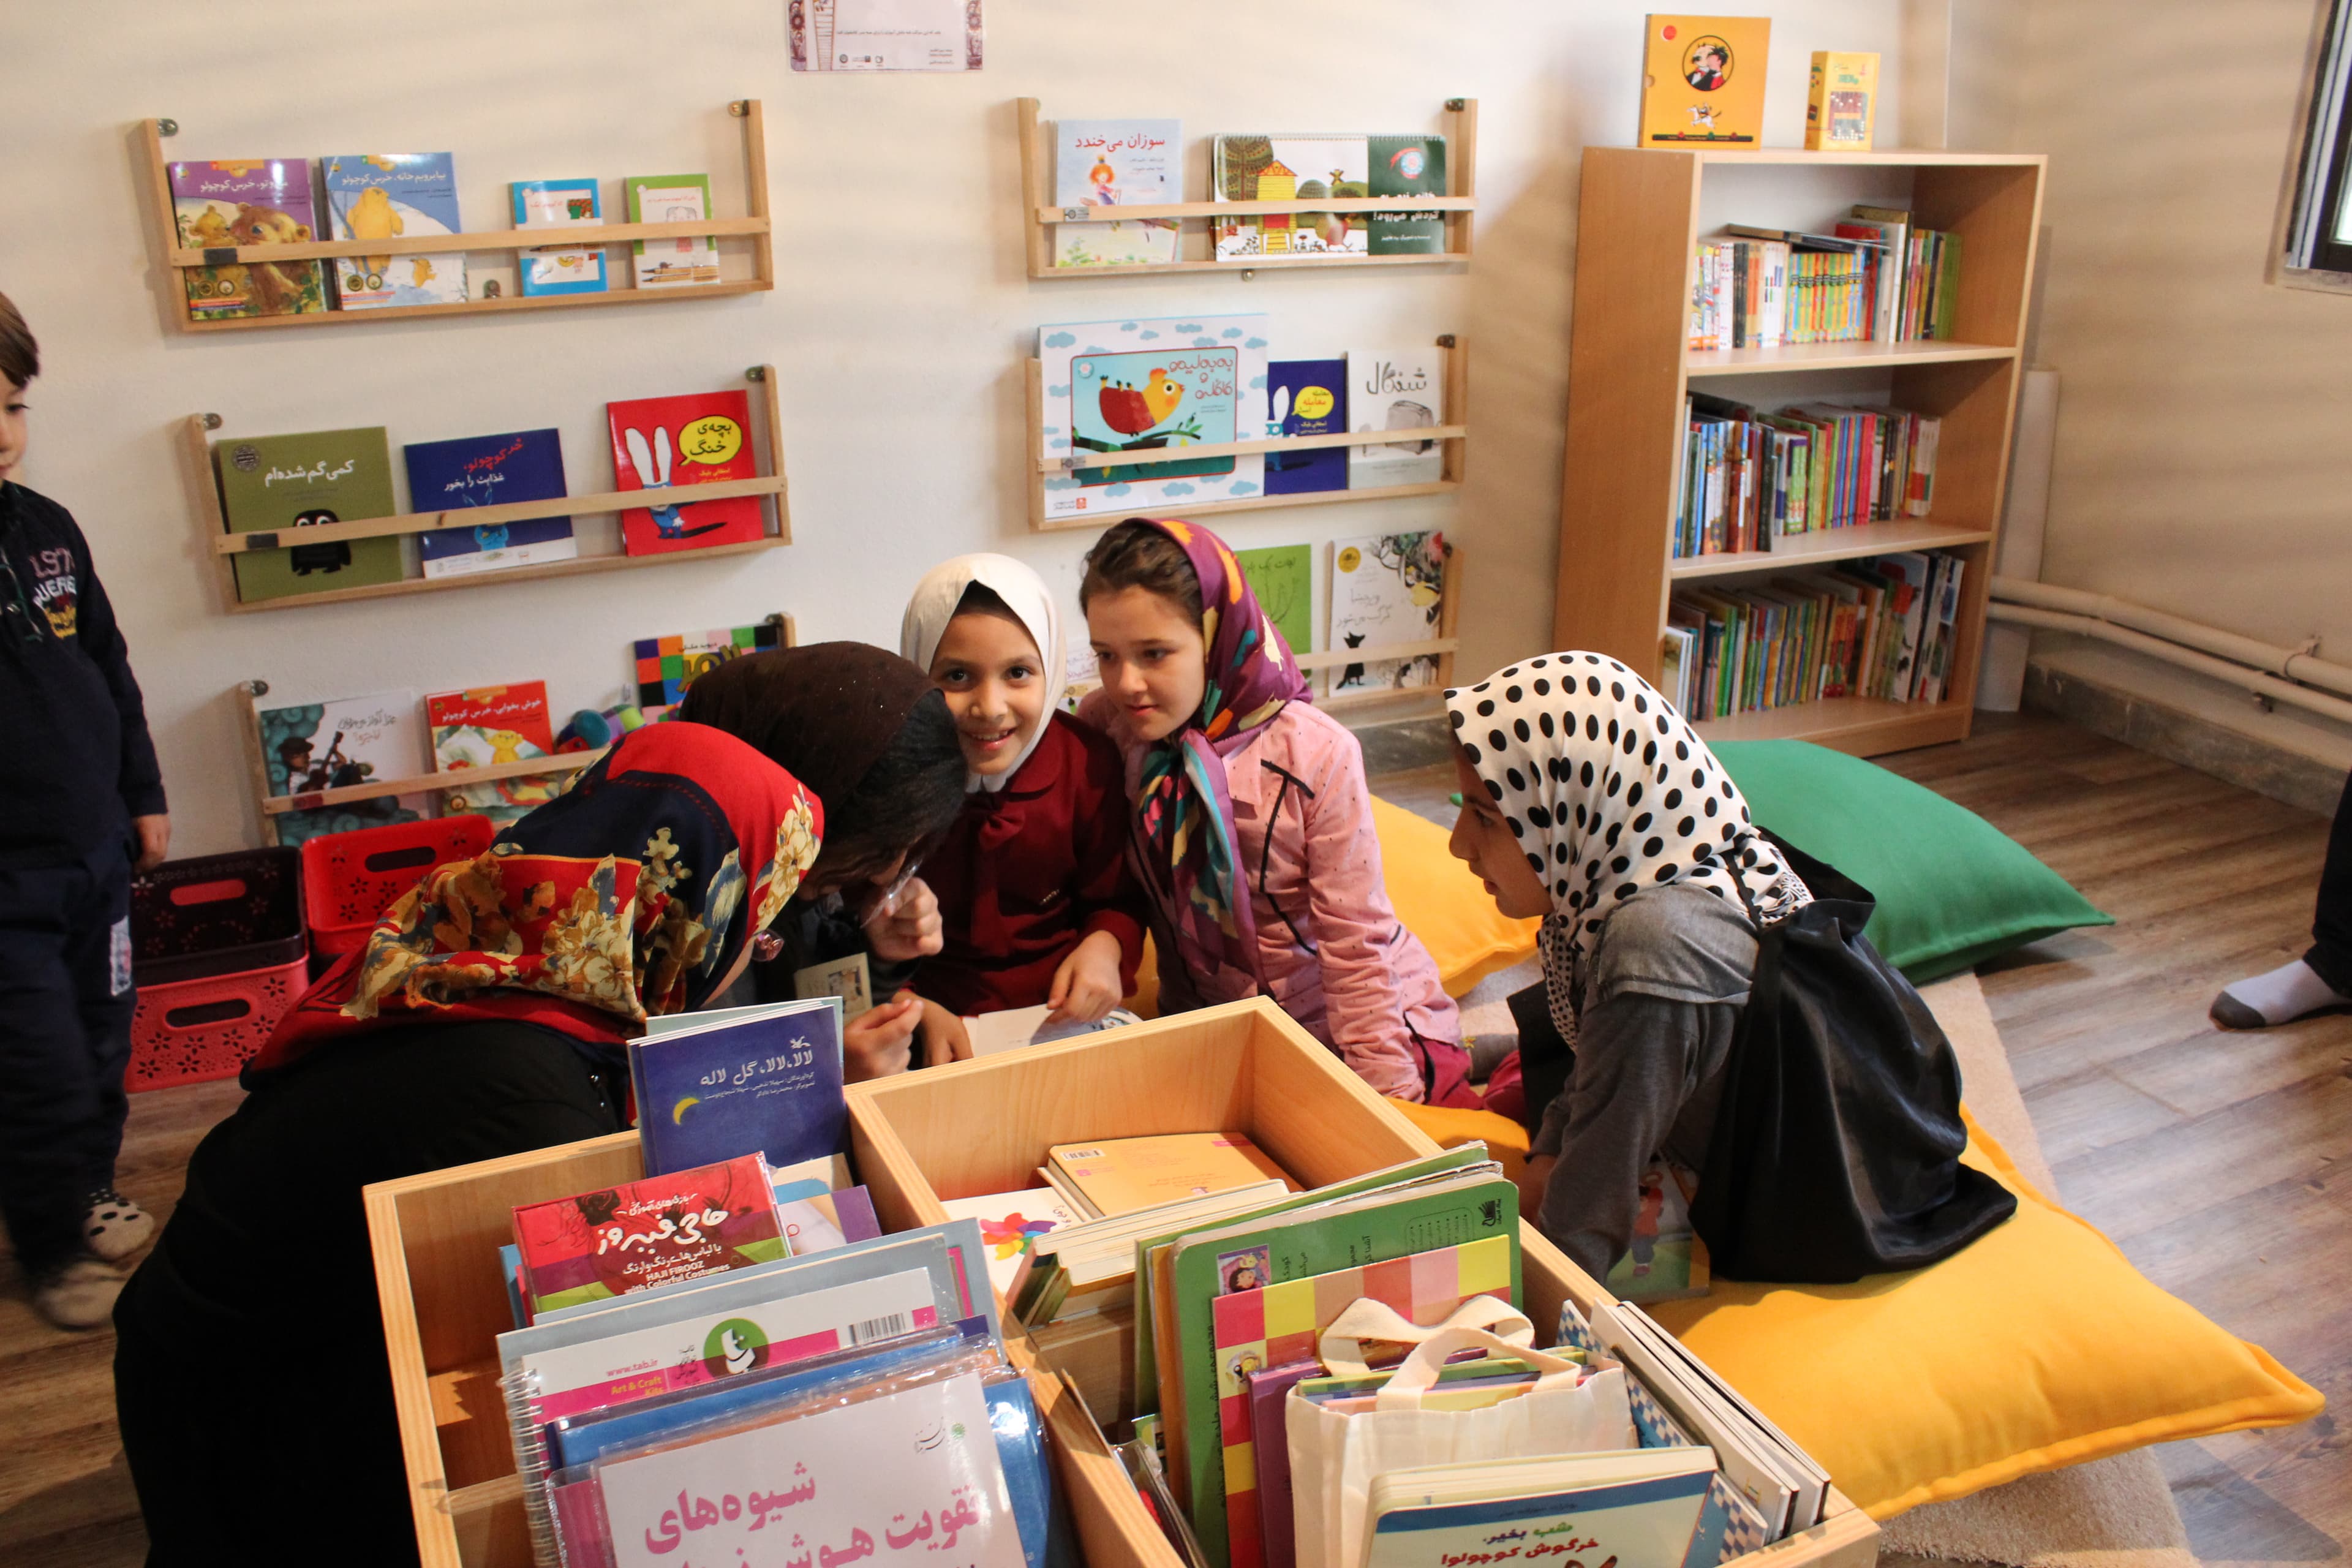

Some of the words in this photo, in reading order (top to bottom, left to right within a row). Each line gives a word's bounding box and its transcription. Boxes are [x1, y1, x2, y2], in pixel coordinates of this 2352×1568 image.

[1127, 133, 1166, 150] سوزان
[200, 179, 231, 192] کوچولو
[231, 179, 255, 192] خرس
[342, 173, 371, 186] کوچولو
[370, 176, 393, 185] خرس
[690, 439, 726, 456] خنگ
[307, 461, 326, 484] گم
[326, 459, 355, 480] کمی
[444, 478, 466, 491] بخور
[467, 474, 475, 488] را
[477, 472, 505, 486] غذایت
[521, 698, 541, 710] خوش
[442, 709, 468, 722] کوچولو
[700, 1068, 726, 1086] لاله
[733, 1060, 758, 1085] گل
[597, 1213, 677, 1256] فیروز
[674, 1208, 729, 1245] حاجی
[646, 1270, 669, 1281] HAJI
[668, 1260, 705, 1276] FIROOZ
[647, 1273, 685, 1290] Colorful
[685, 1264, 731, 1281] Costumes
[606, 1359, 658, 1378] www.tab.ir
[611, 1382, 627, 1395] Art
[628, 1381, 636, 1390] &
[638, 1376, 662, 1389] Craft
[645, 1385, 664, 1396] Kits
[645, 1461, 816, 1555] شیوه‌های
[1533, 1522, 1573, 1537] شب
[1525, 1538, 1600, 1558] خرگوش
